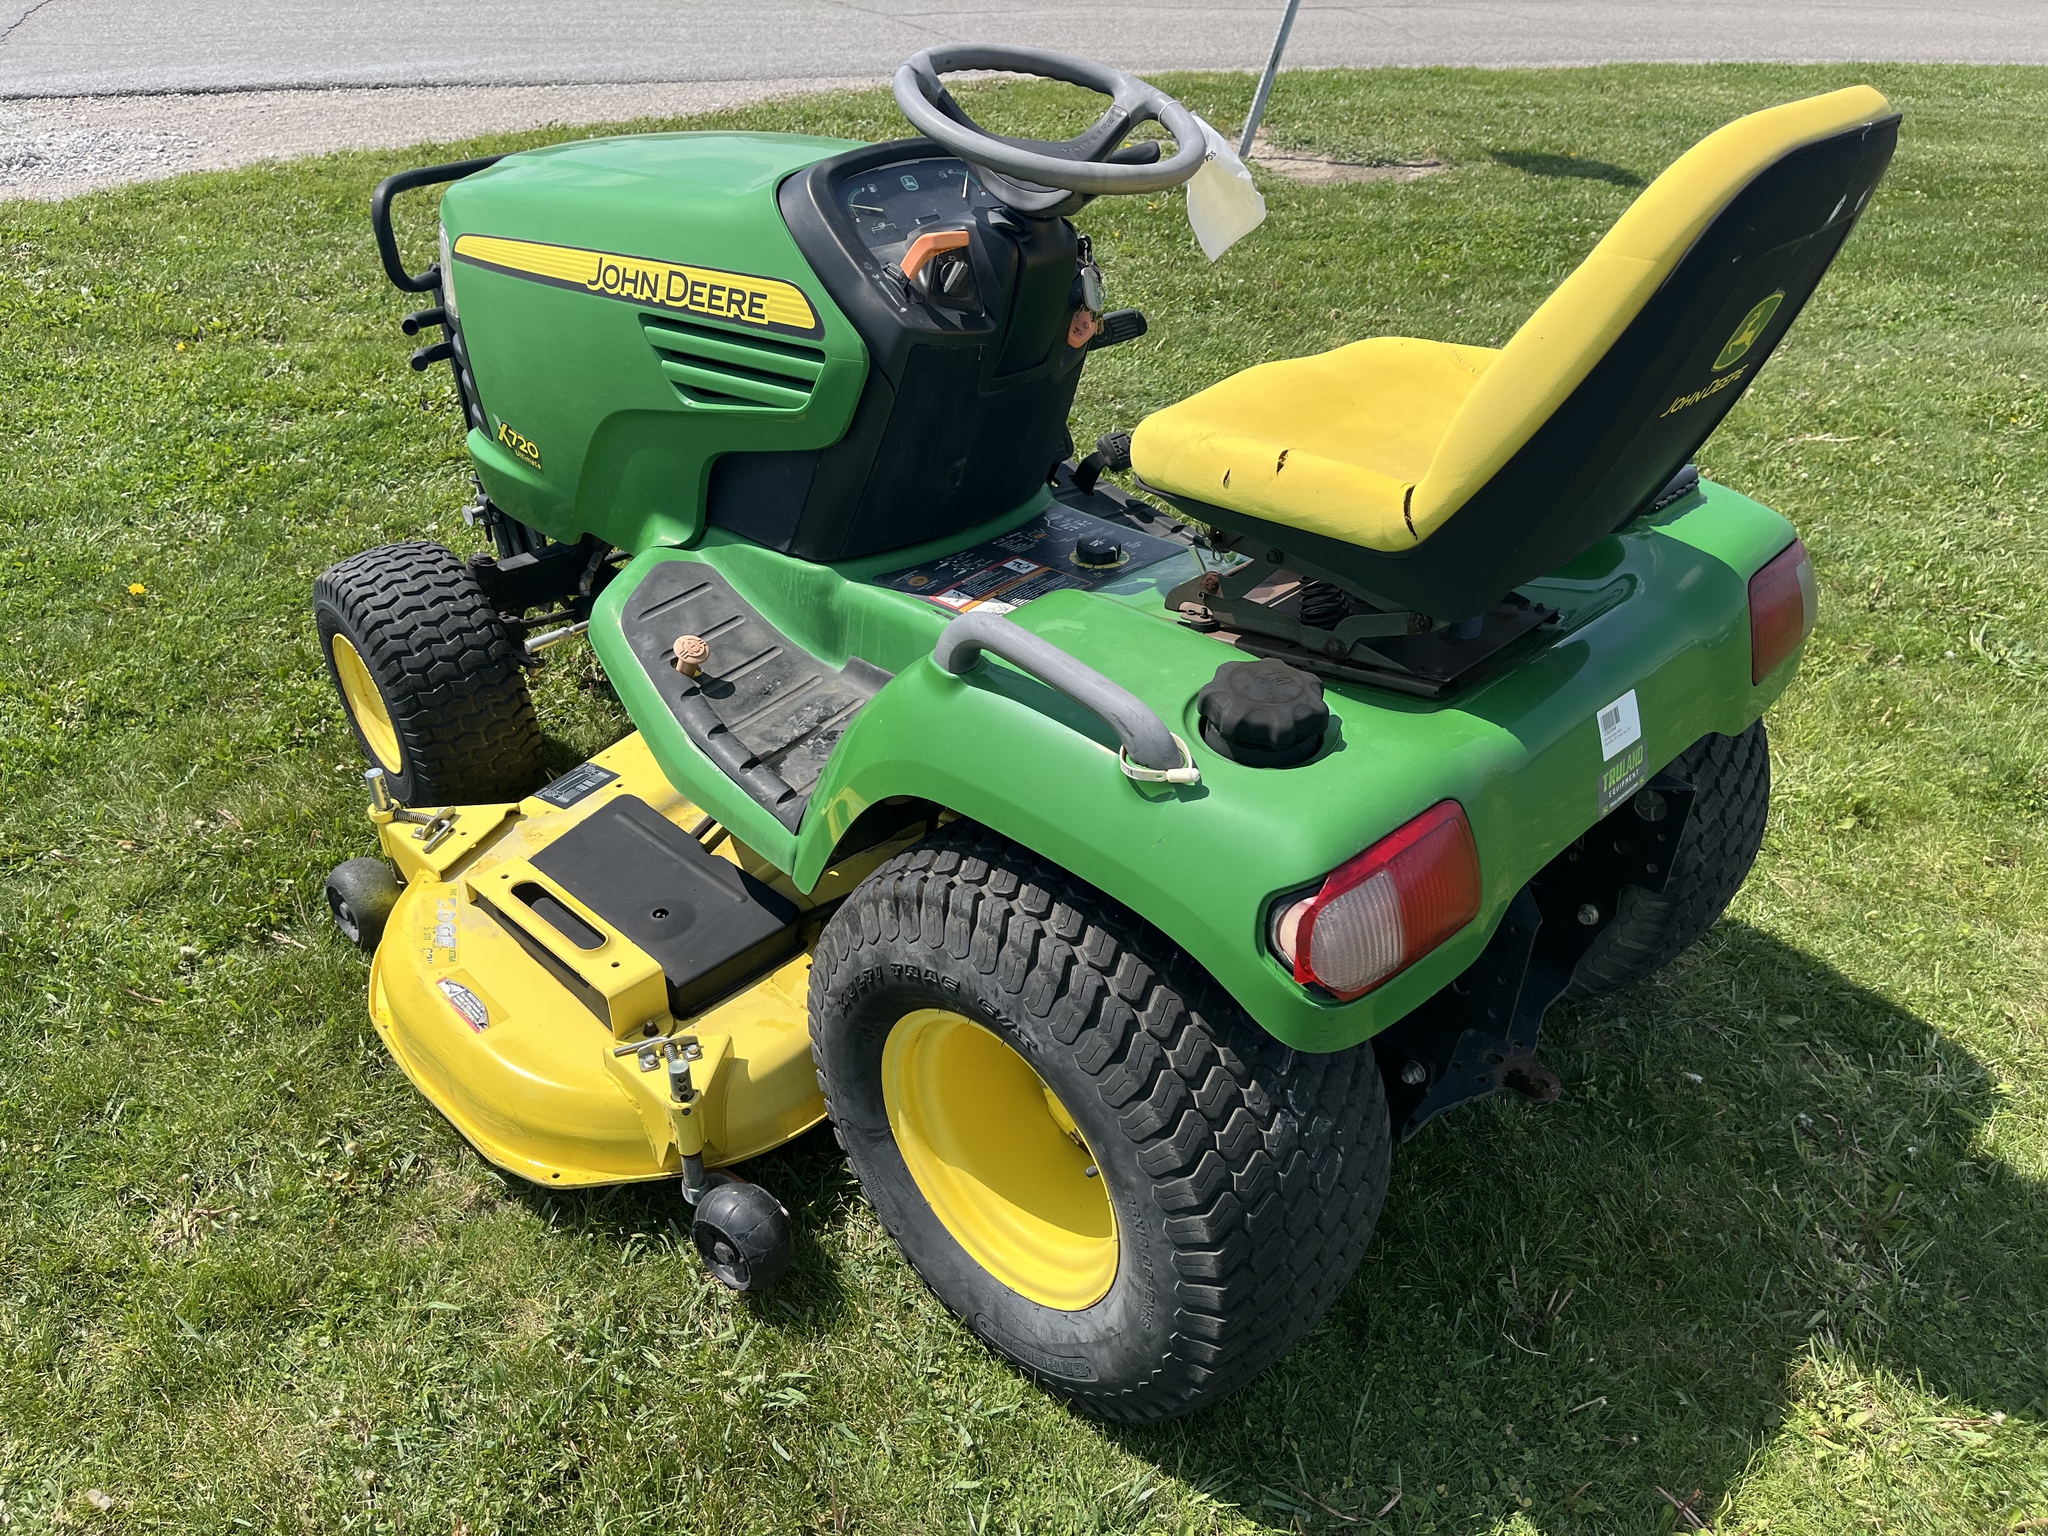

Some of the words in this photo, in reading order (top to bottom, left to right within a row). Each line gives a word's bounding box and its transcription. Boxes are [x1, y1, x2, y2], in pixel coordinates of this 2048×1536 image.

[587, 256, 660, 299] JOHN
[665, 269, 768, 320] DEERE
[1660, 388, 1707, 418] JOHN
[1701, 364, 1749, 399] DEERE
[1602, 744, 1644, 793] TRULAND
[1608, 768, 1640, 798] EQUIPMENT
[836, 964, 882, 1014] MULTI
[889, 961, 961, 993] TRAC
